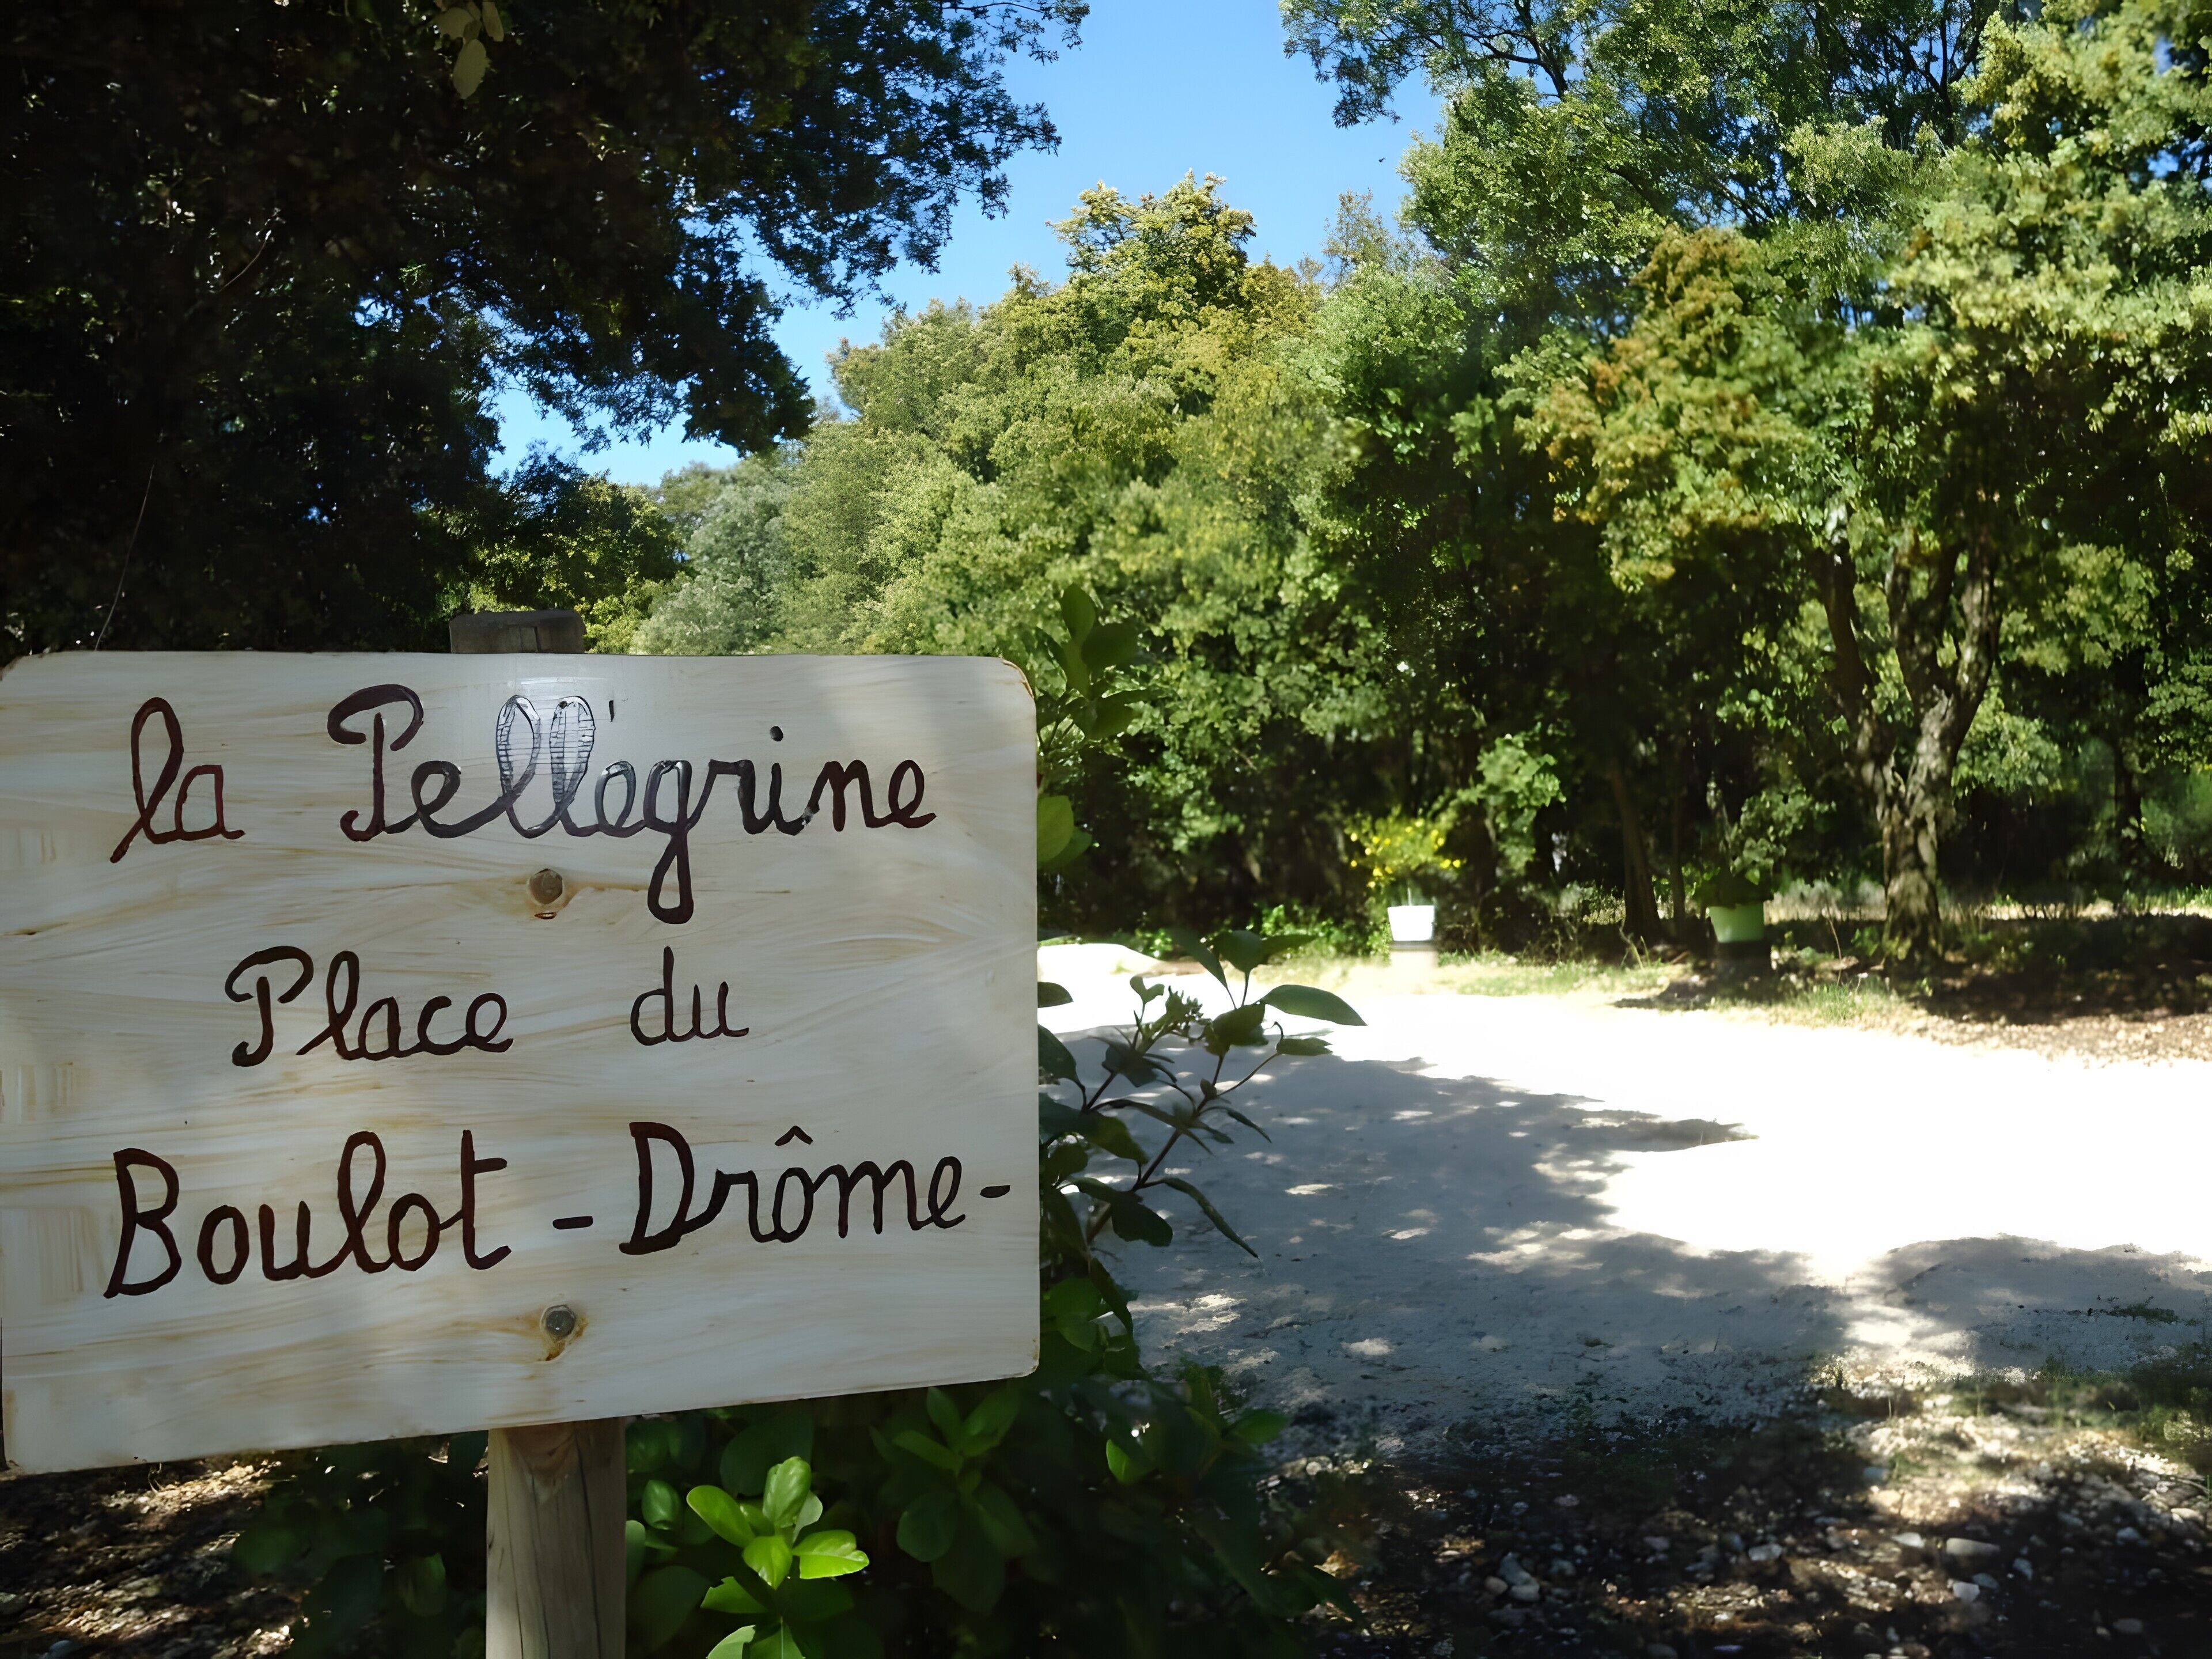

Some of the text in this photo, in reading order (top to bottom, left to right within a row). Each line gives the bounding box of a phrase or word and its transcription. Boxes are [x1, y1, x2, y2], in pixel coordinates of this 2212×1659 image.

[109, 696, 246, 864] la
[224, 945, 749, 1067] Place du
[103, 1129, 513, 1300] Boulot
